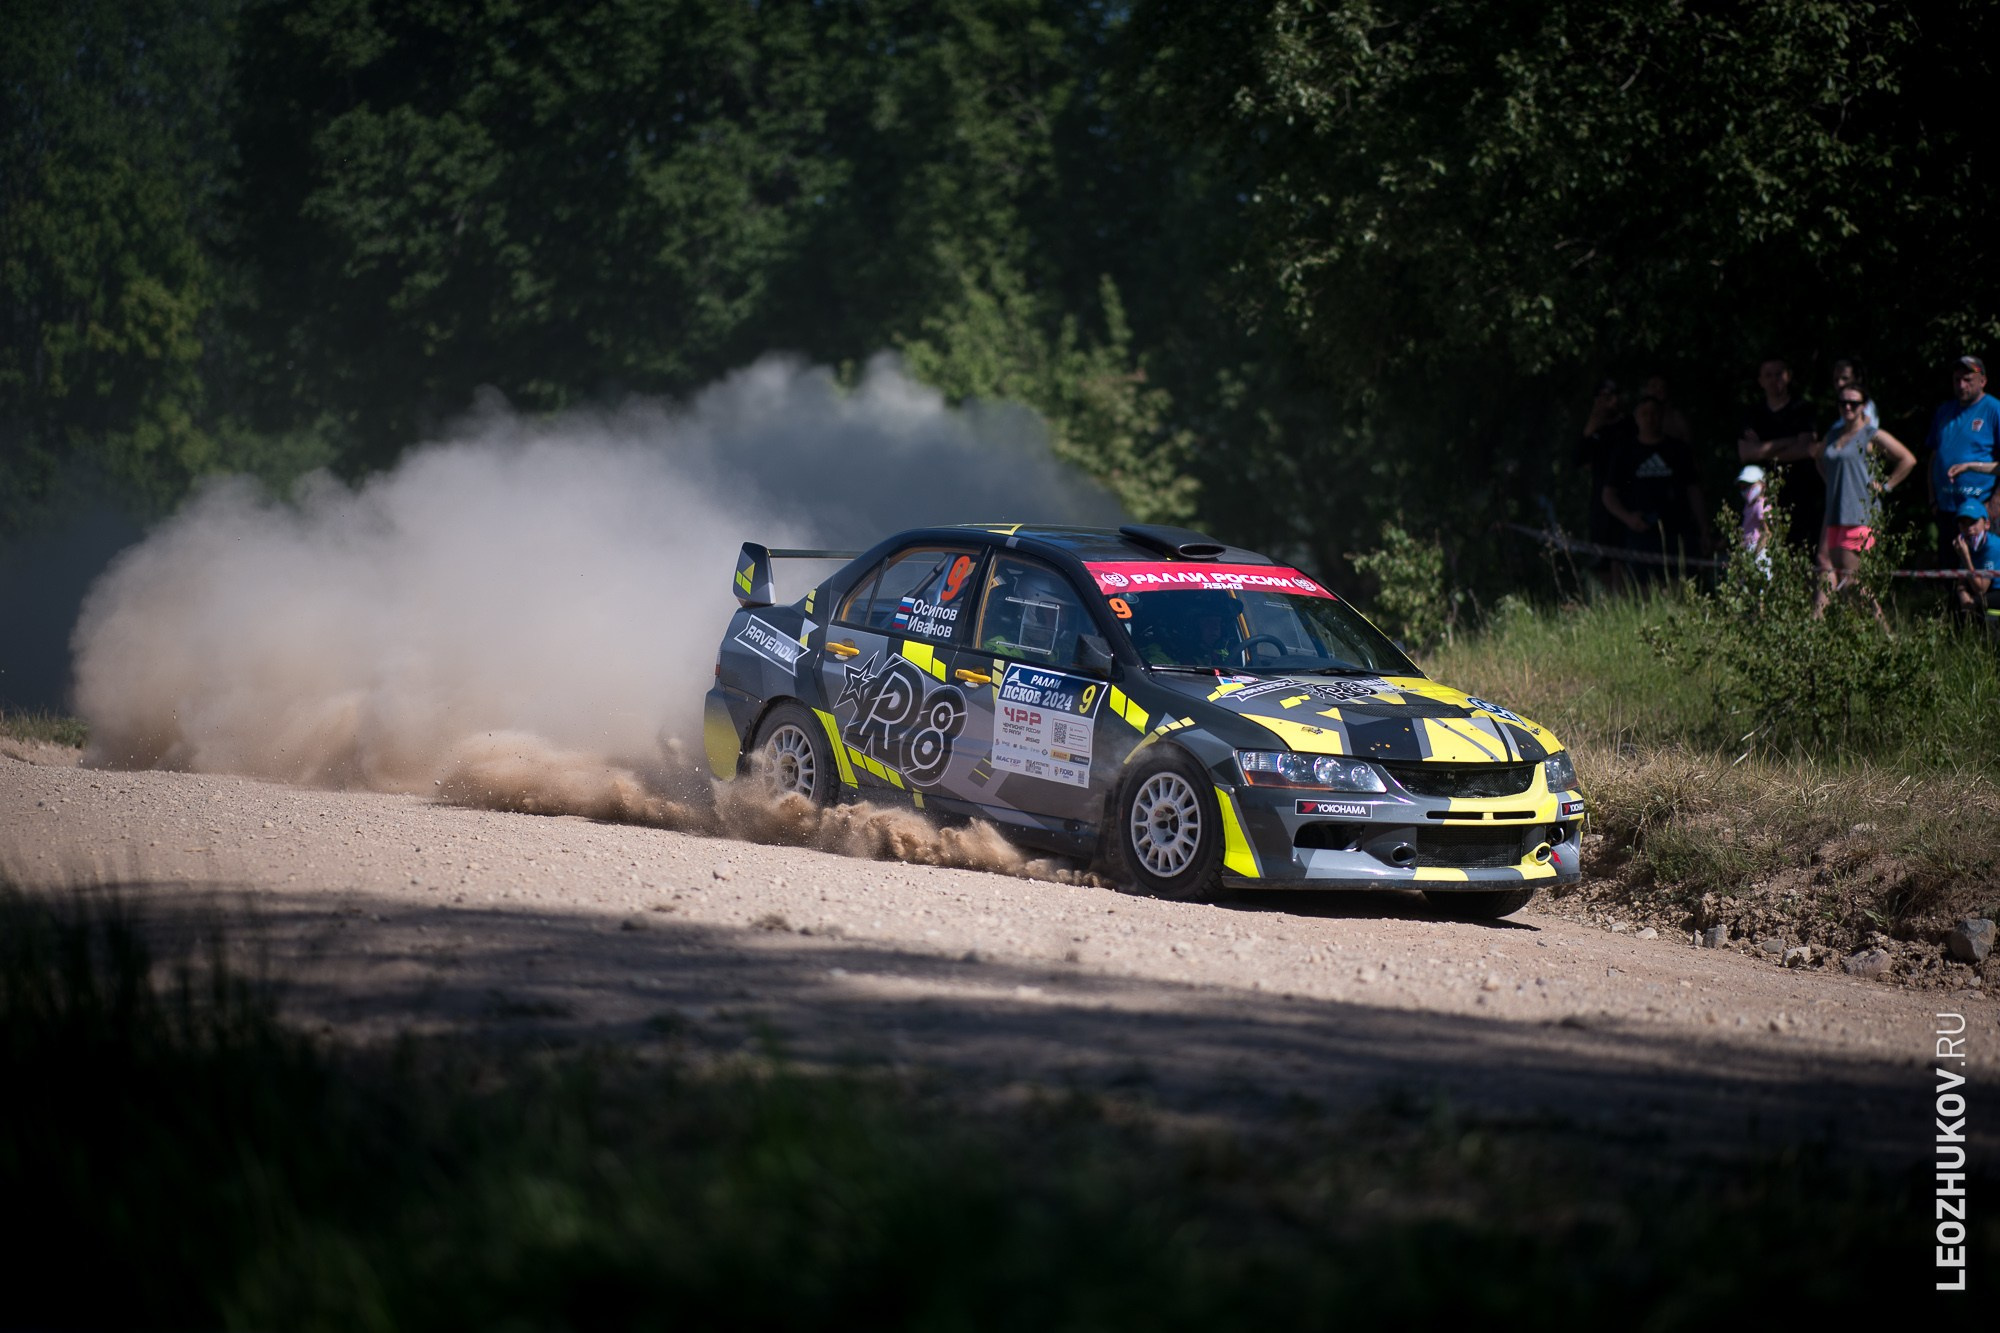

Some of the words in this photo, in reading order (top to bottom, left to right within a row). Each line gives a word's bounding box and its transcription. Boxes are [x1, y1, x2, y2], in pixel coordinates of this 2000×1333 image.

[941, 555, 971, 601] 9
[1130, 572, 1207, 585] РАЛЛИ
[1209, 572, 1294, 588] РОССИИ
[913, 599, 958, 621] Осипов
[1108, 597, 1133, 619] 9
[907, 615, 953, 638] Иванов
[745, 624, 798, 664] RAVENOL
[1030, 674, 1062, 690] РАЛЛИ
[1002, 684, 1042, 704] ПСКОВ
[1042, 690, 1073, 711] 2024
[1078, 684, 1097, 714] 9
[842, 652, 968, 786] R8
[1003, 706, 1042, 726] ЧРР
[1317, 803, 1367, 815] YOKOHAMA
